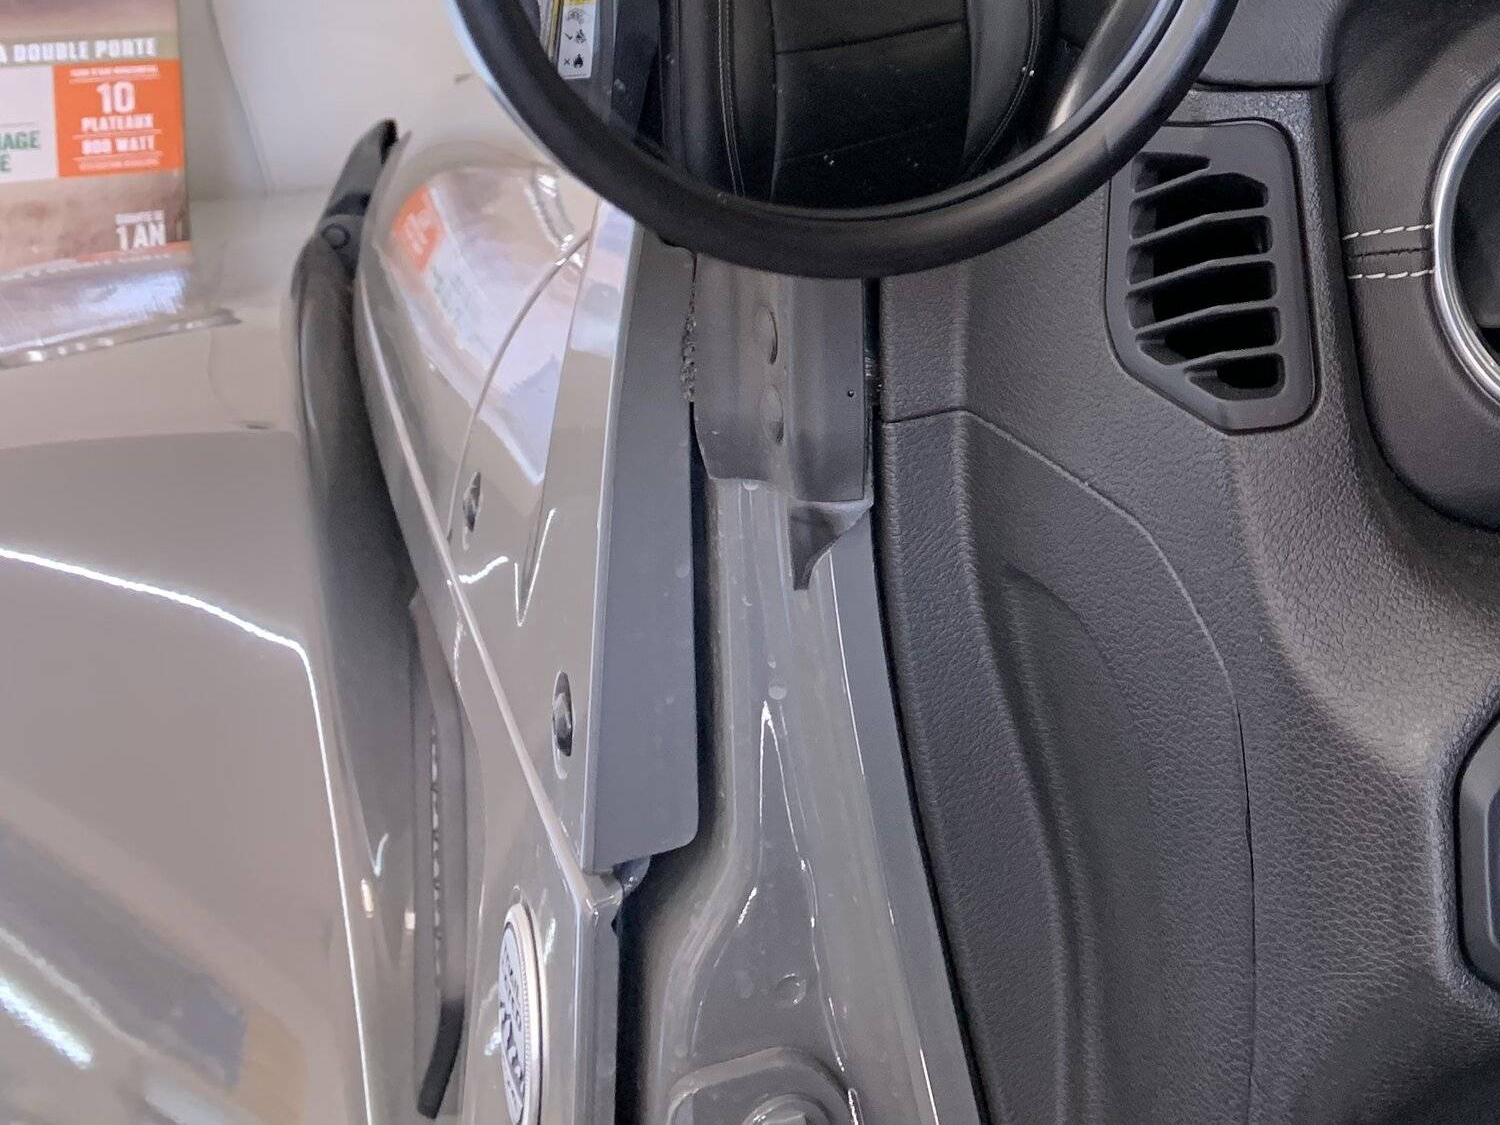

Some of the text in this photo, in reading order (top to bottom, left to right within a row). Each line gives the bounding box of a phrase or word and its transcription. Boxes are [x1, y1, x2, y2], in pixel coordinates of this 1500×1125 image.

[13, 41, 89, 62] DOUBLE
[94, 37, 156, 58] PORTE
[97, 81, 136, 114] 10
[0, 130, 41, 150] AGE
[115, 135, 155, 152] WATT
[115, 221, 167, 251] 1 AN
